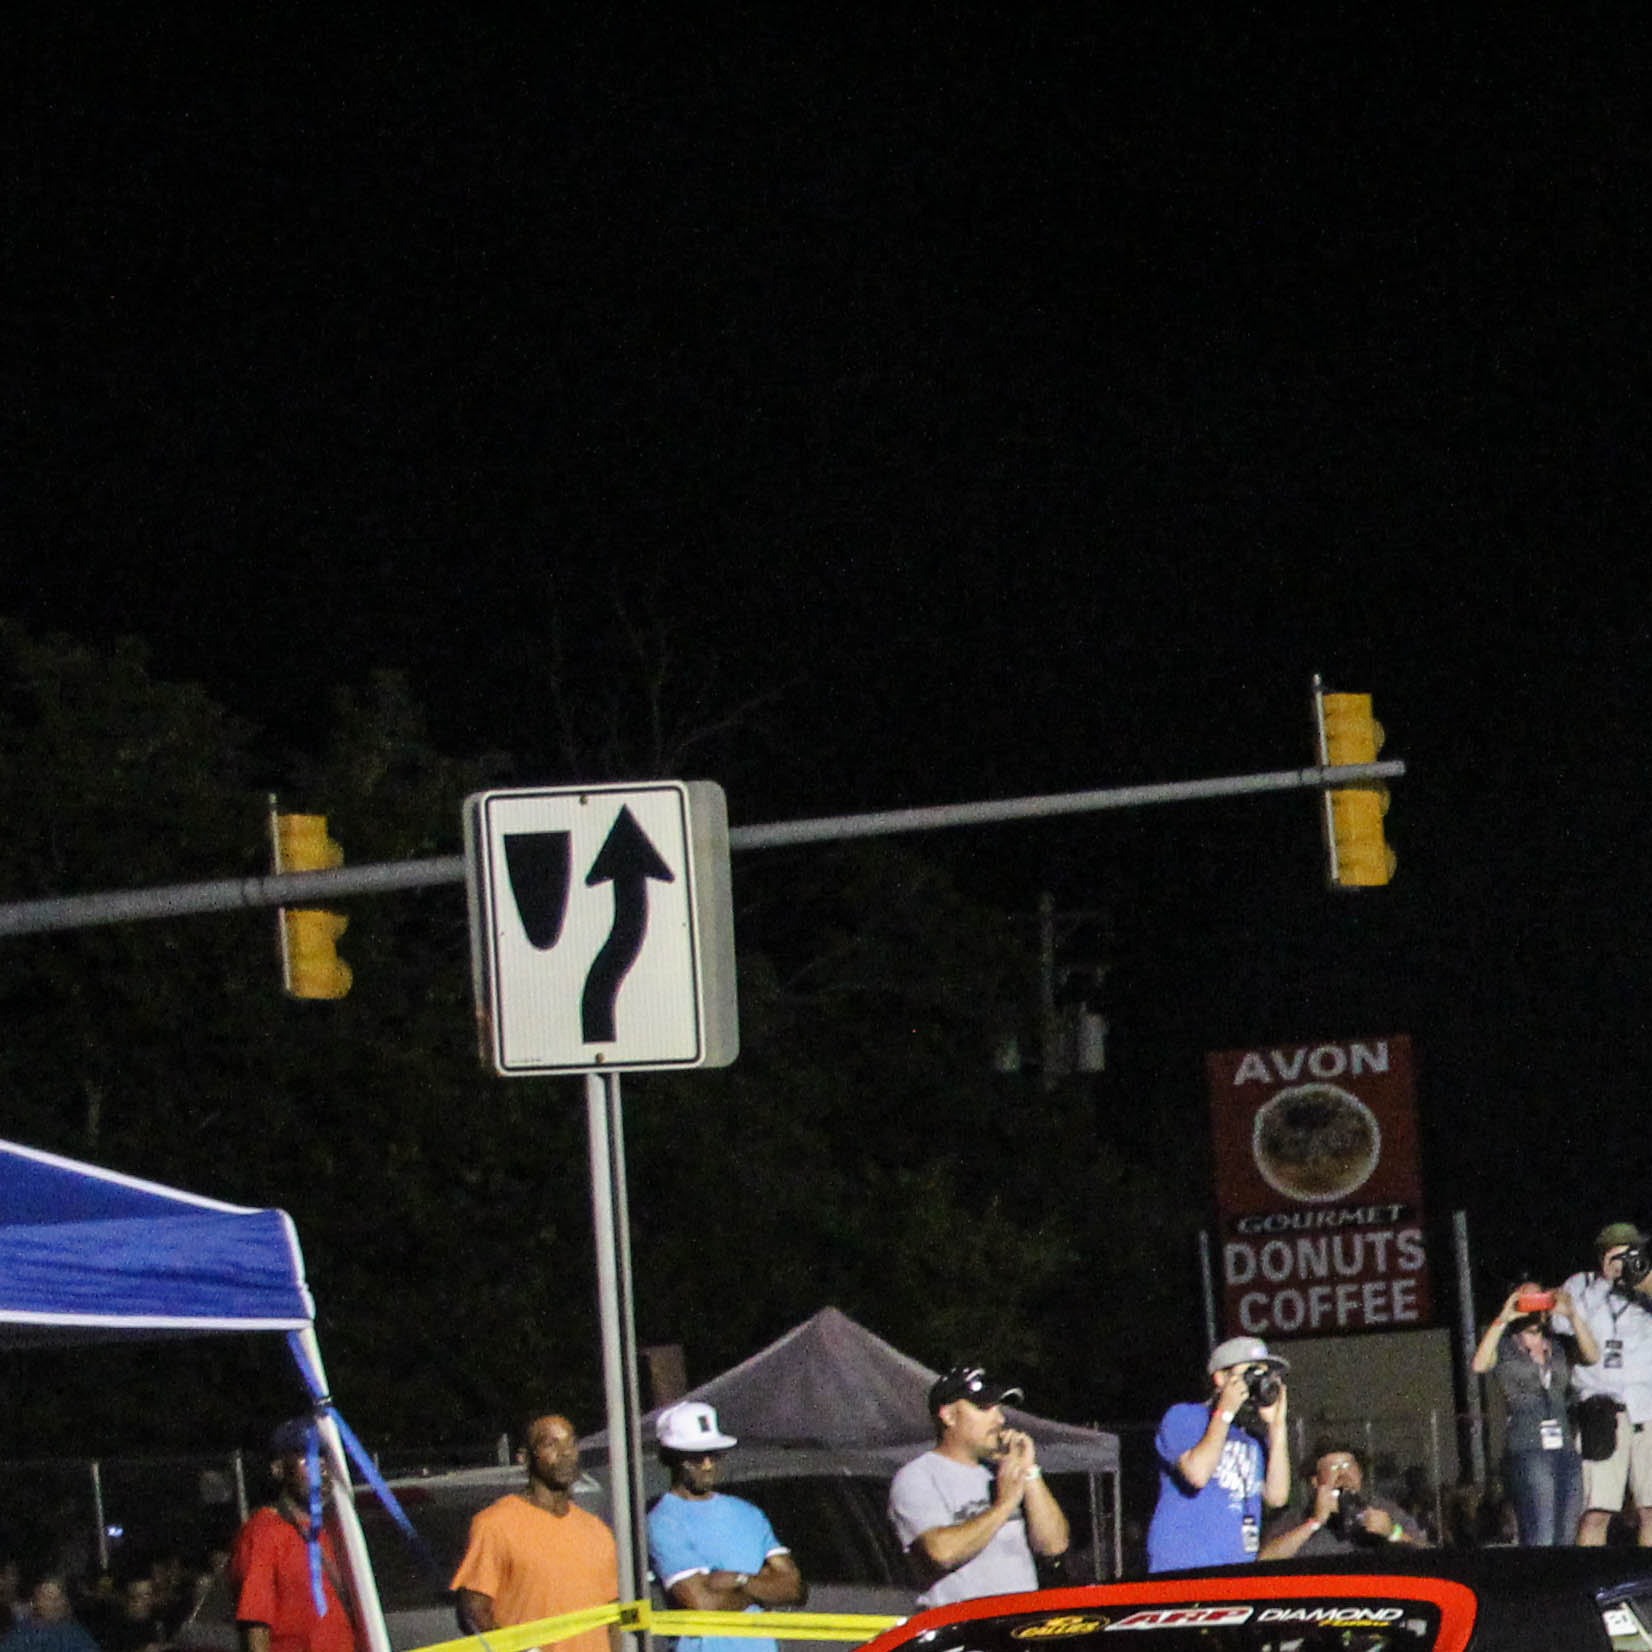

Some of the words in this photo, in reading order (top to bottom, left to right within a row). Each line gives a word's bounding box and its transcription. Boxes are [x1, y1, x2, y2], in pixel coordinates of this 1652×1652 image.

[1233, 1041, 1389, 1086] AVON
[1238, 1204, 1405, 1231] GOURMET
[1223, 1229, 1426, 1285] DONUTS
[1239, 1280, 1419, 1333] COFFEE
[1120, 1608, 1248, 1627] ARP
[1257, 1608, 1404, 1622] DIAMOND
